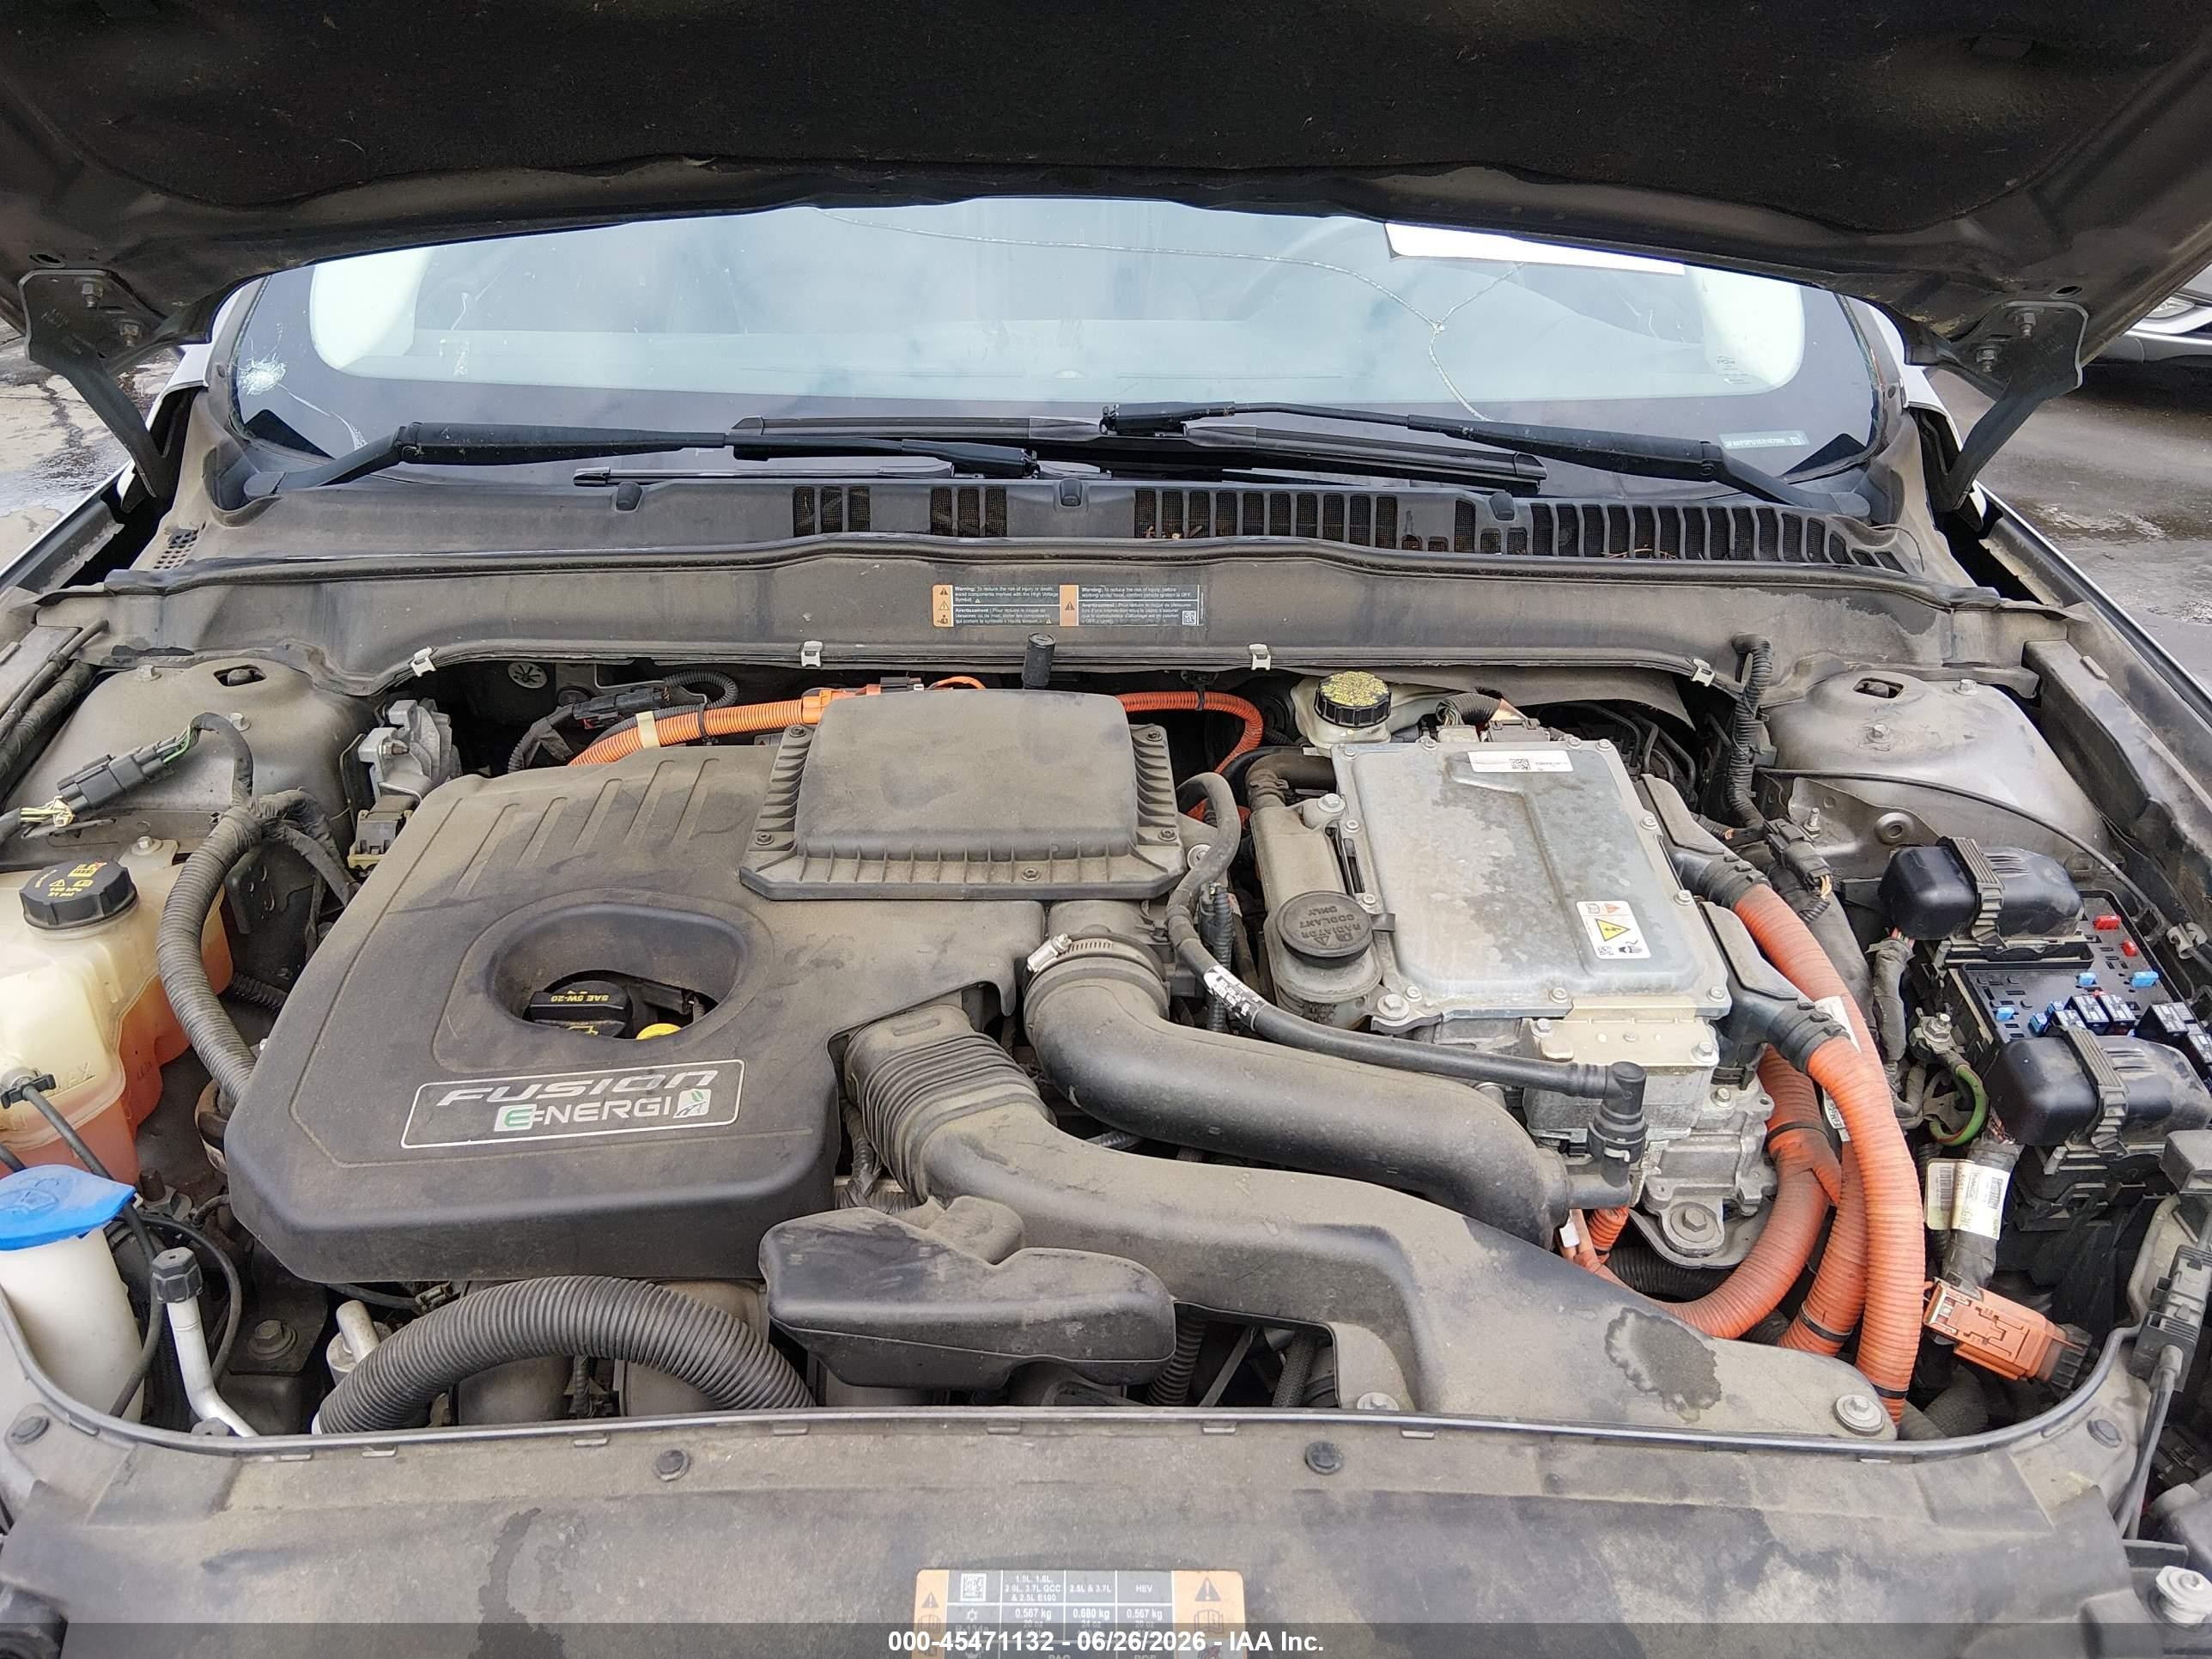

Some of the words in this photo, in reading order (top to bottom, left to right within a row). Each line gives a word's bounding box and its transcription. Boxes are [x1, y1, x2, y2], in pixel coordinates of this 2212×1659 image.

[1309, 905, 1338, 916] ONLY
[1299, 914, 1355, 928] COOLANT
[1301, 923, 1361, 939] RADIATOR
[436, 1070, 719, 1107] FUSION
[500, 1097, 672, 1132] ENERGI
[1096, 1584, 1112, 1593] 3.7L
[1136, 1584, 1153, 1593] HEV
[1037, 1593, 1057, 1601] E100
[1015, 1607, 1039, 1619] 0.567
[1041, 1607, 1052, 1622] kg
[1073, 1607, 1097, 1619] 0.680
[1098, 1607, 1110, 1621] kg
[1127, 1607, 1150, 1620] 0.567
[1152, 1607, 1164, 1621] kg
